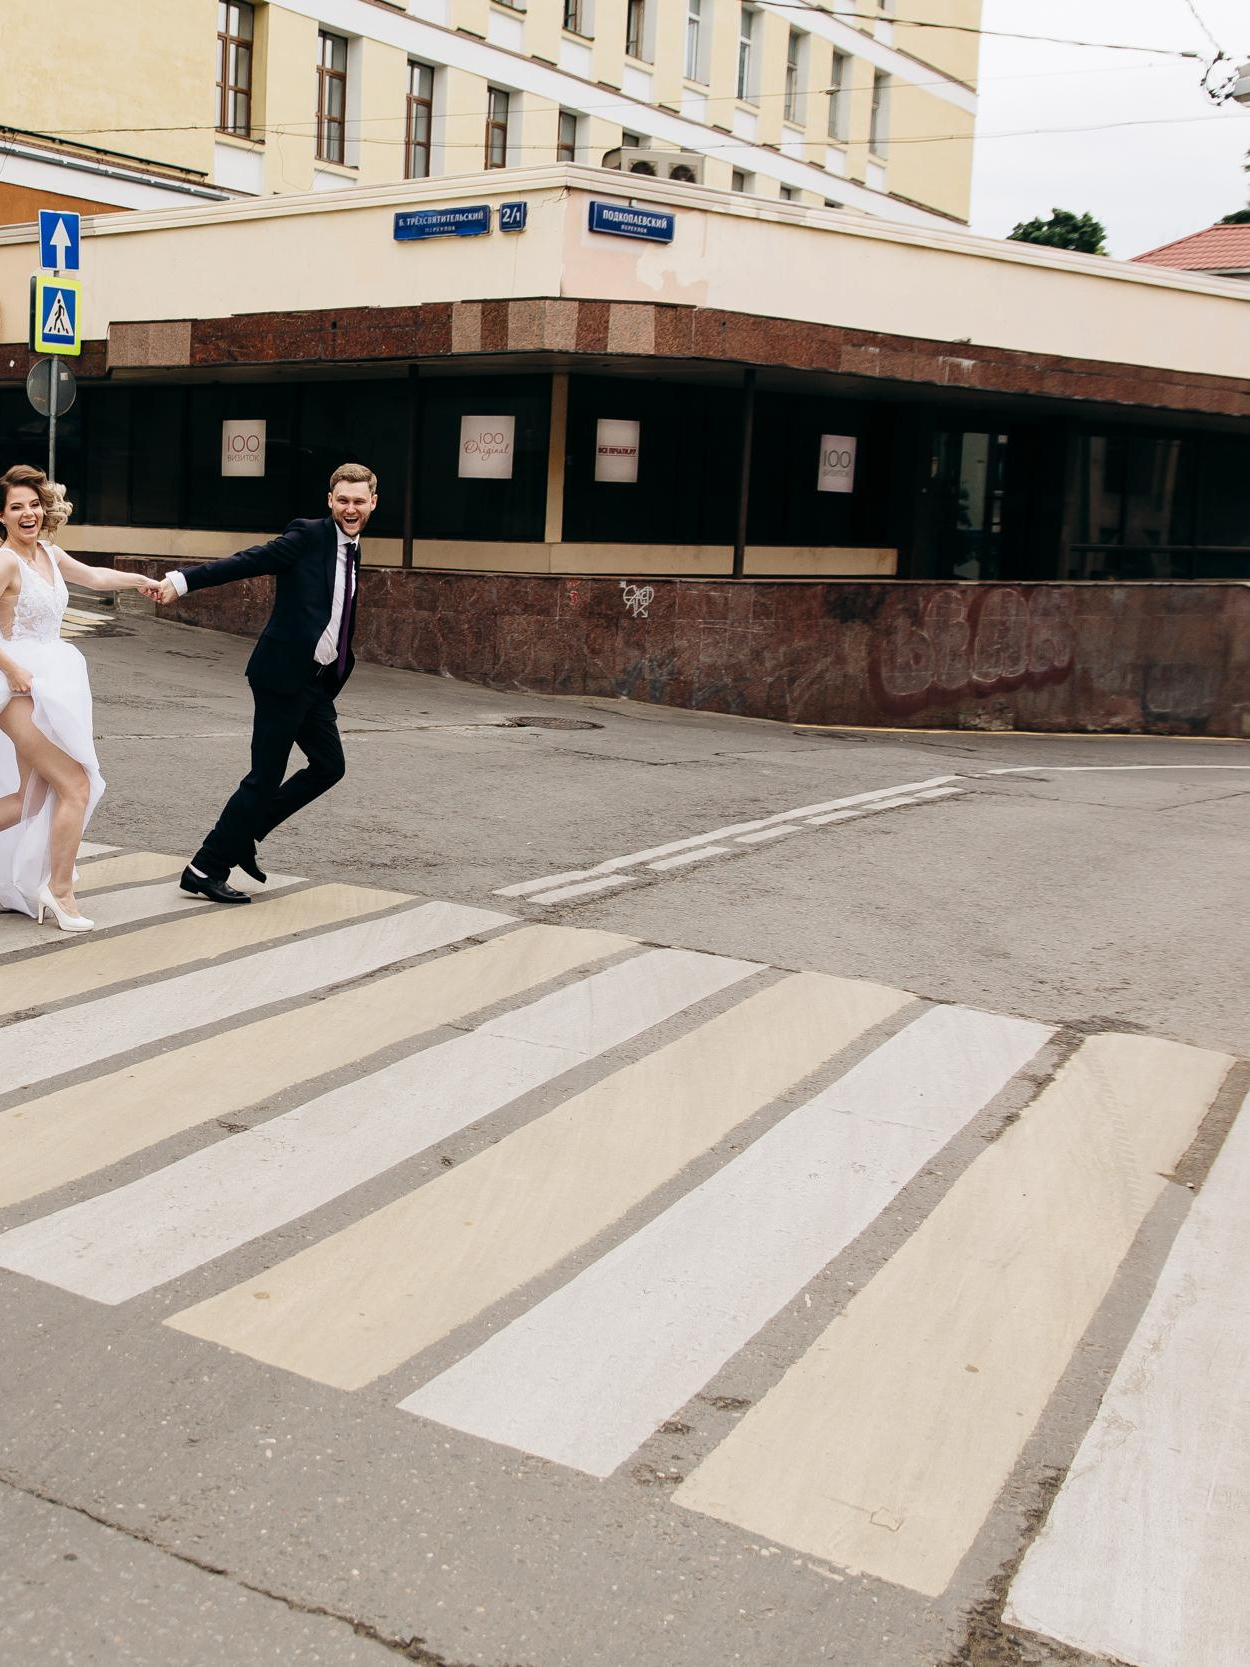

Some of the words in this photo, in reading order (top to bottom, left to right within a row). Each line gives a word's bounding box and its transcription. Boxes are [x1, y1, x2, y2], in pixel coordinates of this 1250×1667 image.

[407, 210, 484, 226] ТРЁХСВЯТИТЕЛЬСКИЙ
[502, 207, 521, 224] 2/1
[602, 209, 668, 230] ПОДКОПАЕВСКИЙ
[227, 435, 260, 452] 100
[479, 432, 504, 444] 100
[464, 440, 510, 461] Original
[823, 450, 851, 468] 100
